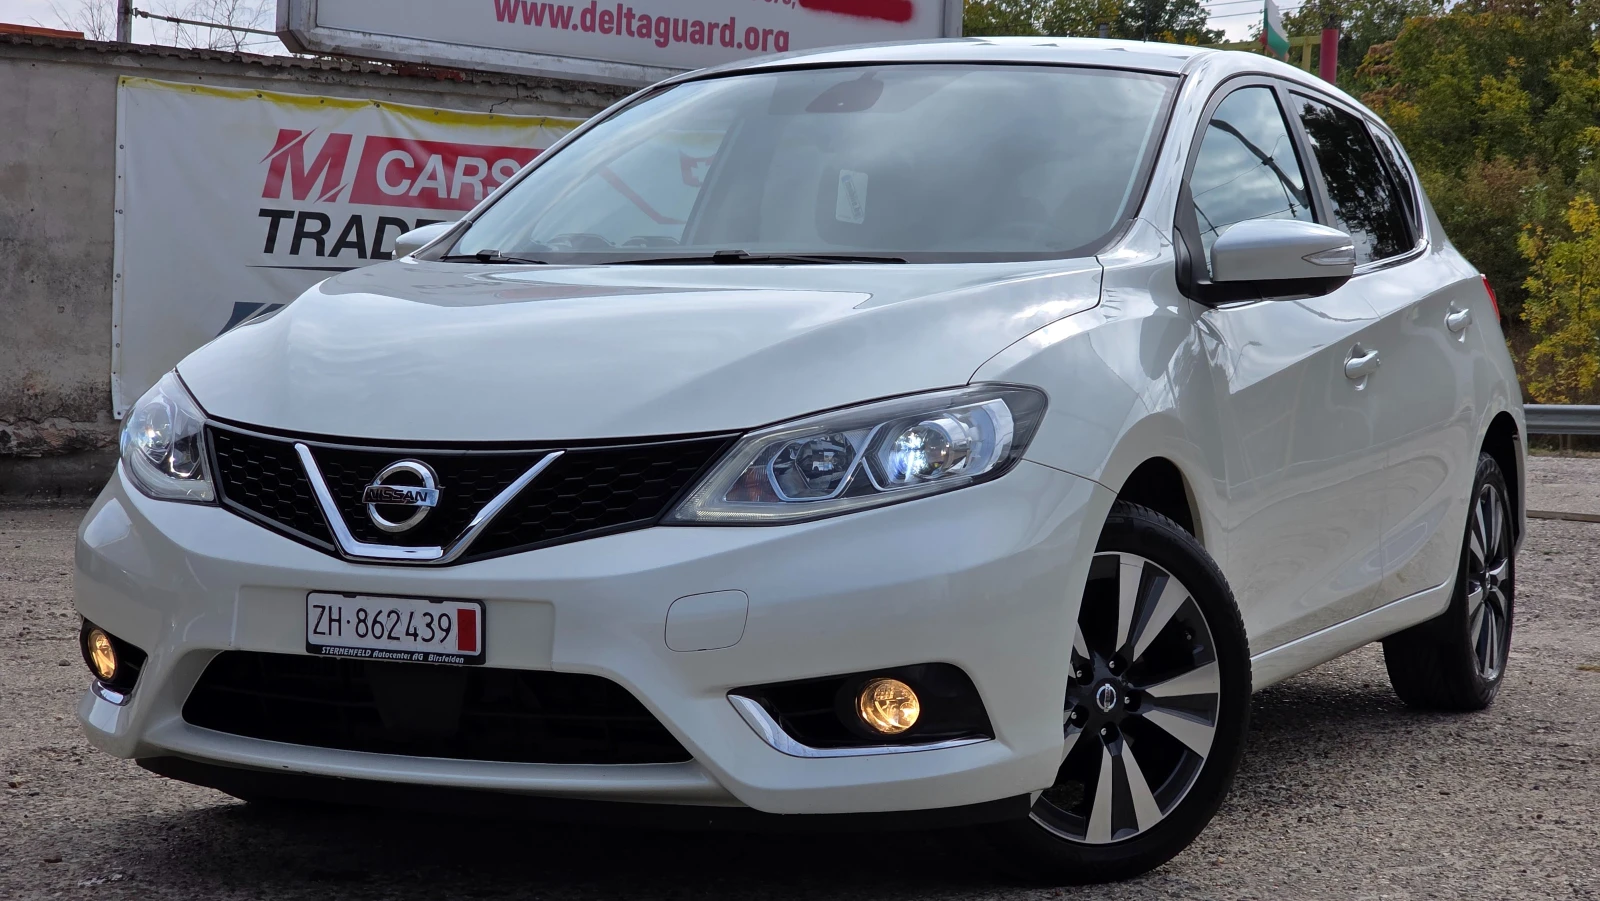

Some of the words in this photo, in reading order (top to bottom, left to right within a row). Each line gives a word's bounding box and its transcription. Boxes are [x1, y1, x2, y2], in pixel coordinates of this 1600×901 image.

[494, 0, 790, 52] www.deltaguard.org
[368, 488, 428, 503] NISSAN
[321, 646, 372, 657] STERNENFELD
[372, 650, 411, 660] Autocenter
[412, 653, 424, 661] AG
[428, 653, 465, 664] Birsfelden
